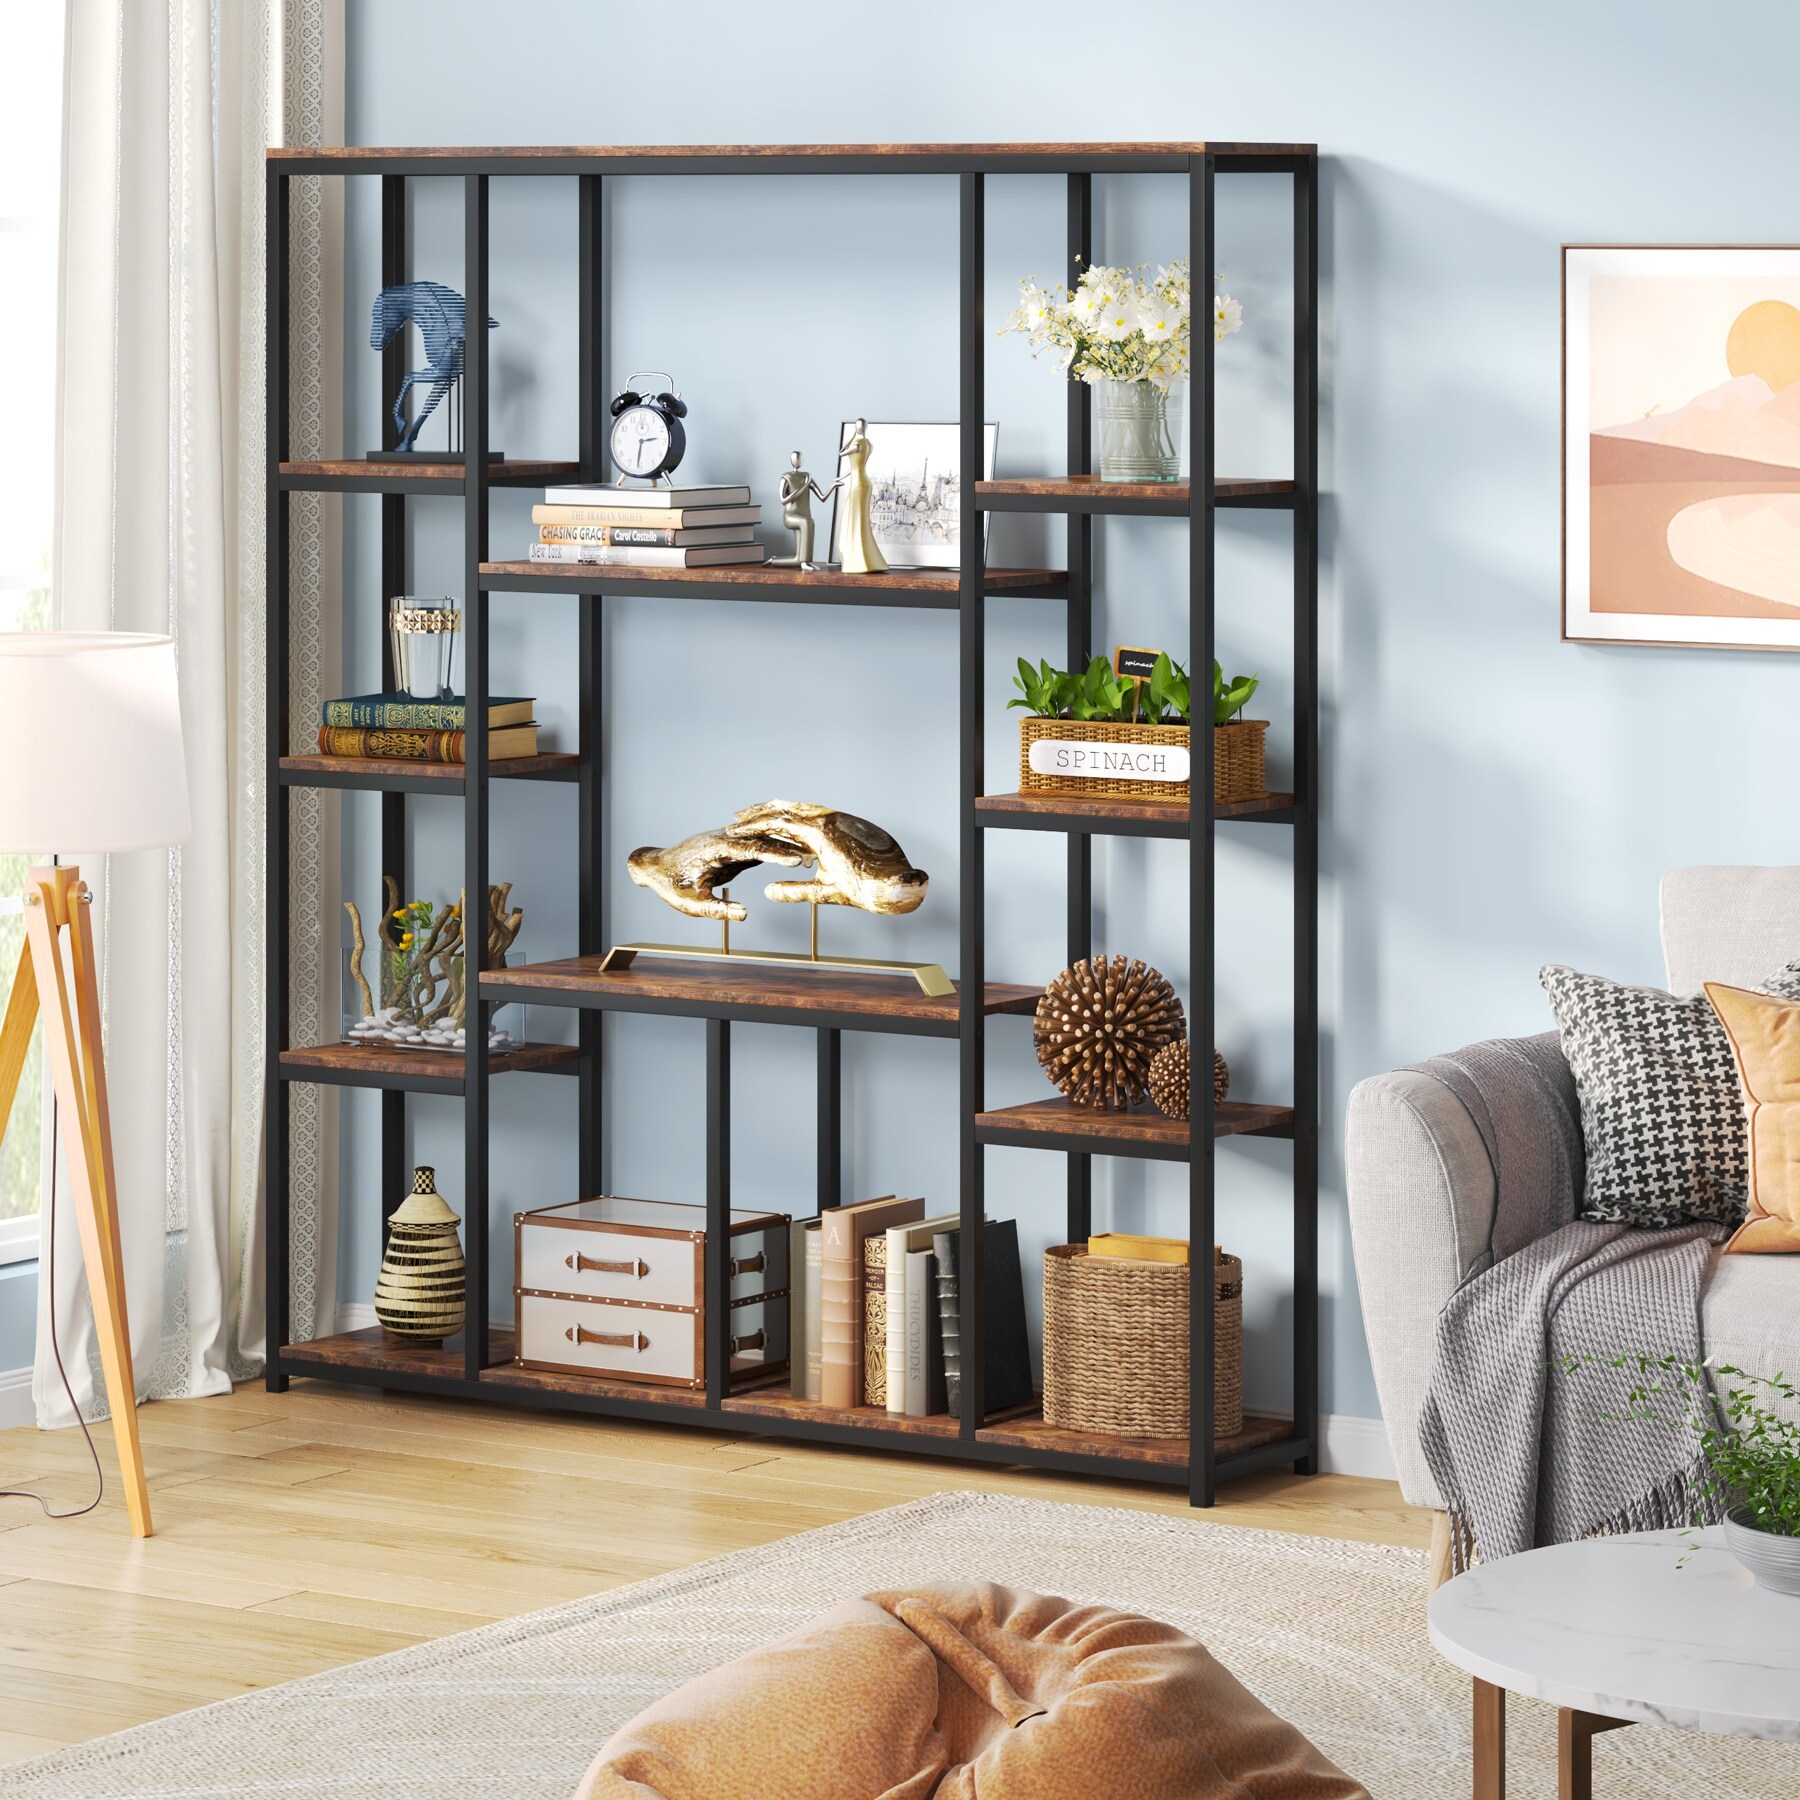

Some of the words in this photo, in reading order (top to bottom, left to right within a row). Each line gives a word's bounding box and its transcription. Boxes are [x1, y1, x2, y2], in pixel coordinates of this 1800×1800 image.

[621, 425, 628, 433] 10
[571, 510, 586, 521] THE
[587, 511, 616, 522] ARABIAN
[617, 512, 644, 523] NIGHTS
[541, 525, 577, 541] CHASING
[579, 526, 607, 541] GRACE
[614, 529, 631, 542] Carol
[632, 529, 657, 543] Costello
[531, 543, 546, 558] New
[1056, 749, 1167, 773] SPINACH
[826, 1226, 843, 1246] A
[910, 1290, 920, 1381] THUCYDIDES
